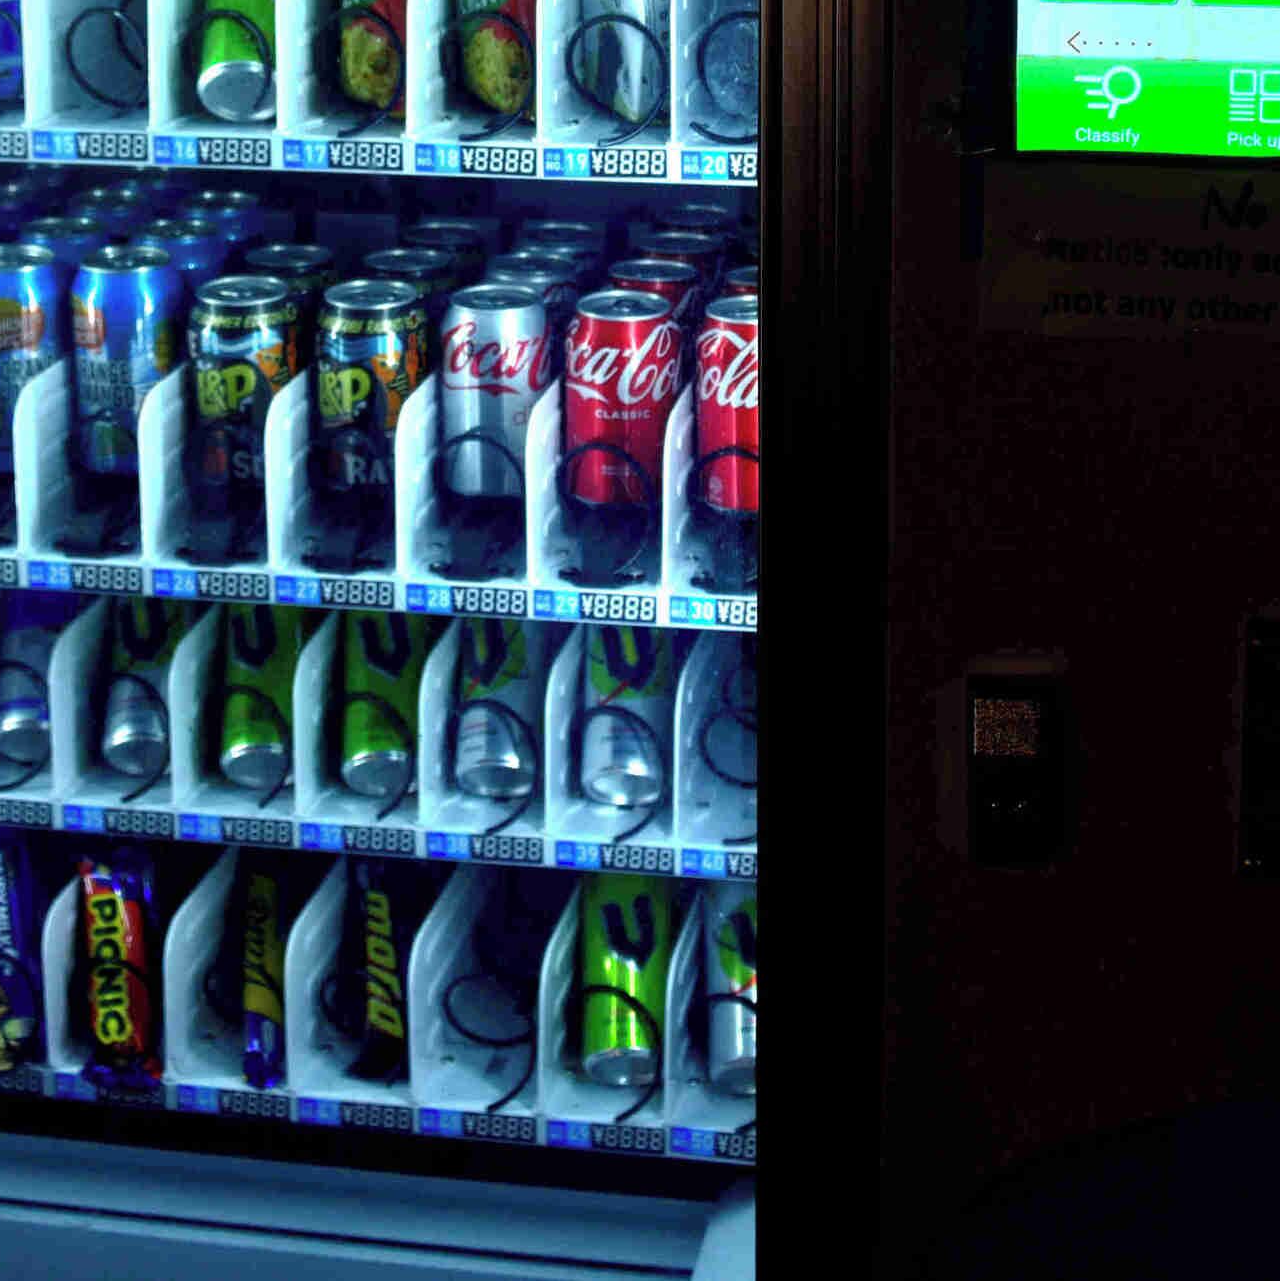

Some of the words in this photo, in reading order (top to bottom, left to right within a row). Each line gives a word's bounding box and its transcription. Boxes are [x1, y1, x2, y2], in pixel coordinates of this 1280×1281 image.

[78, 131, 149, 161] ¥8888
[1074, 125, 1141, 148] Classify
[1227, 131, 1262, 148] Pick
[174, 139, 197, 162] 16
[199, 138, 272, 168] ¥8888
[306, 141, 328, 164] 17
[330, 139, 404, 169] ¥8888
[439, 144, 460, 167] 18
[462, 146, 537, 176] ¥8888
[566, 151, 588, 174] 19
[590, 149, 667, 179] ¥8888
[704, 152, 728, 176] 20
[1201, 180, 1269, 230] No
[1118, 293, 1176, 326] any
[1185, 293, 1273, 324] other
[594, 408, 652, 420] CLASSIC
[73, 563, 143, 594] ¥8888
[198, 572, 271, 602] ¥8888
[321, 578, 395, 608] ¥8888
[428, 587, 452, 610] 28
[453, 585, 528, 616] ¥8888
[557, 593, 580, 616] 29
[581, 591, 657, 622] ¥8888
[691, 599, 716, 622] 30
[601, 843, 675, 873] ¥8888
[88, 893, 134, 1045] PICNIC
